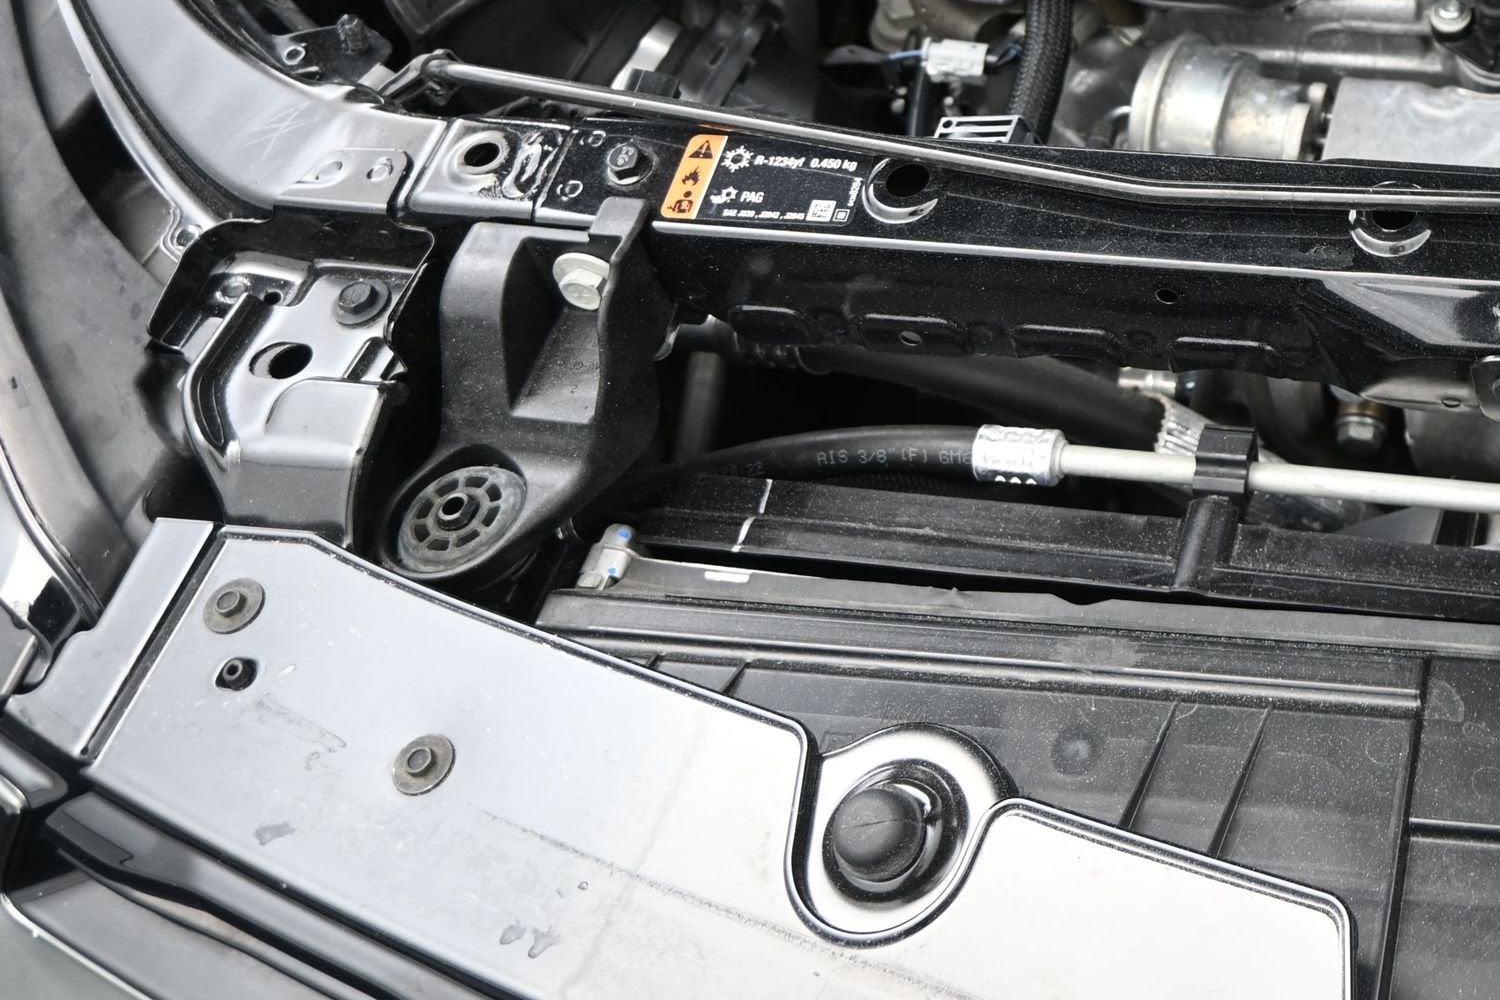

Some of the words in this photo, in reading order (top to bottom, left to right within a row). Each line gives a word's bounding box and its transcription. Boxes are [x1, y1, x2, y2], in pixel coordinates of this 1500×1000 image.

[754, 155, 805, 169] R-1234yf
[810, 158, 841, 169] 0.450
[842, 159, 858, 172] kg
[741, 191, 765, 204] PAG
